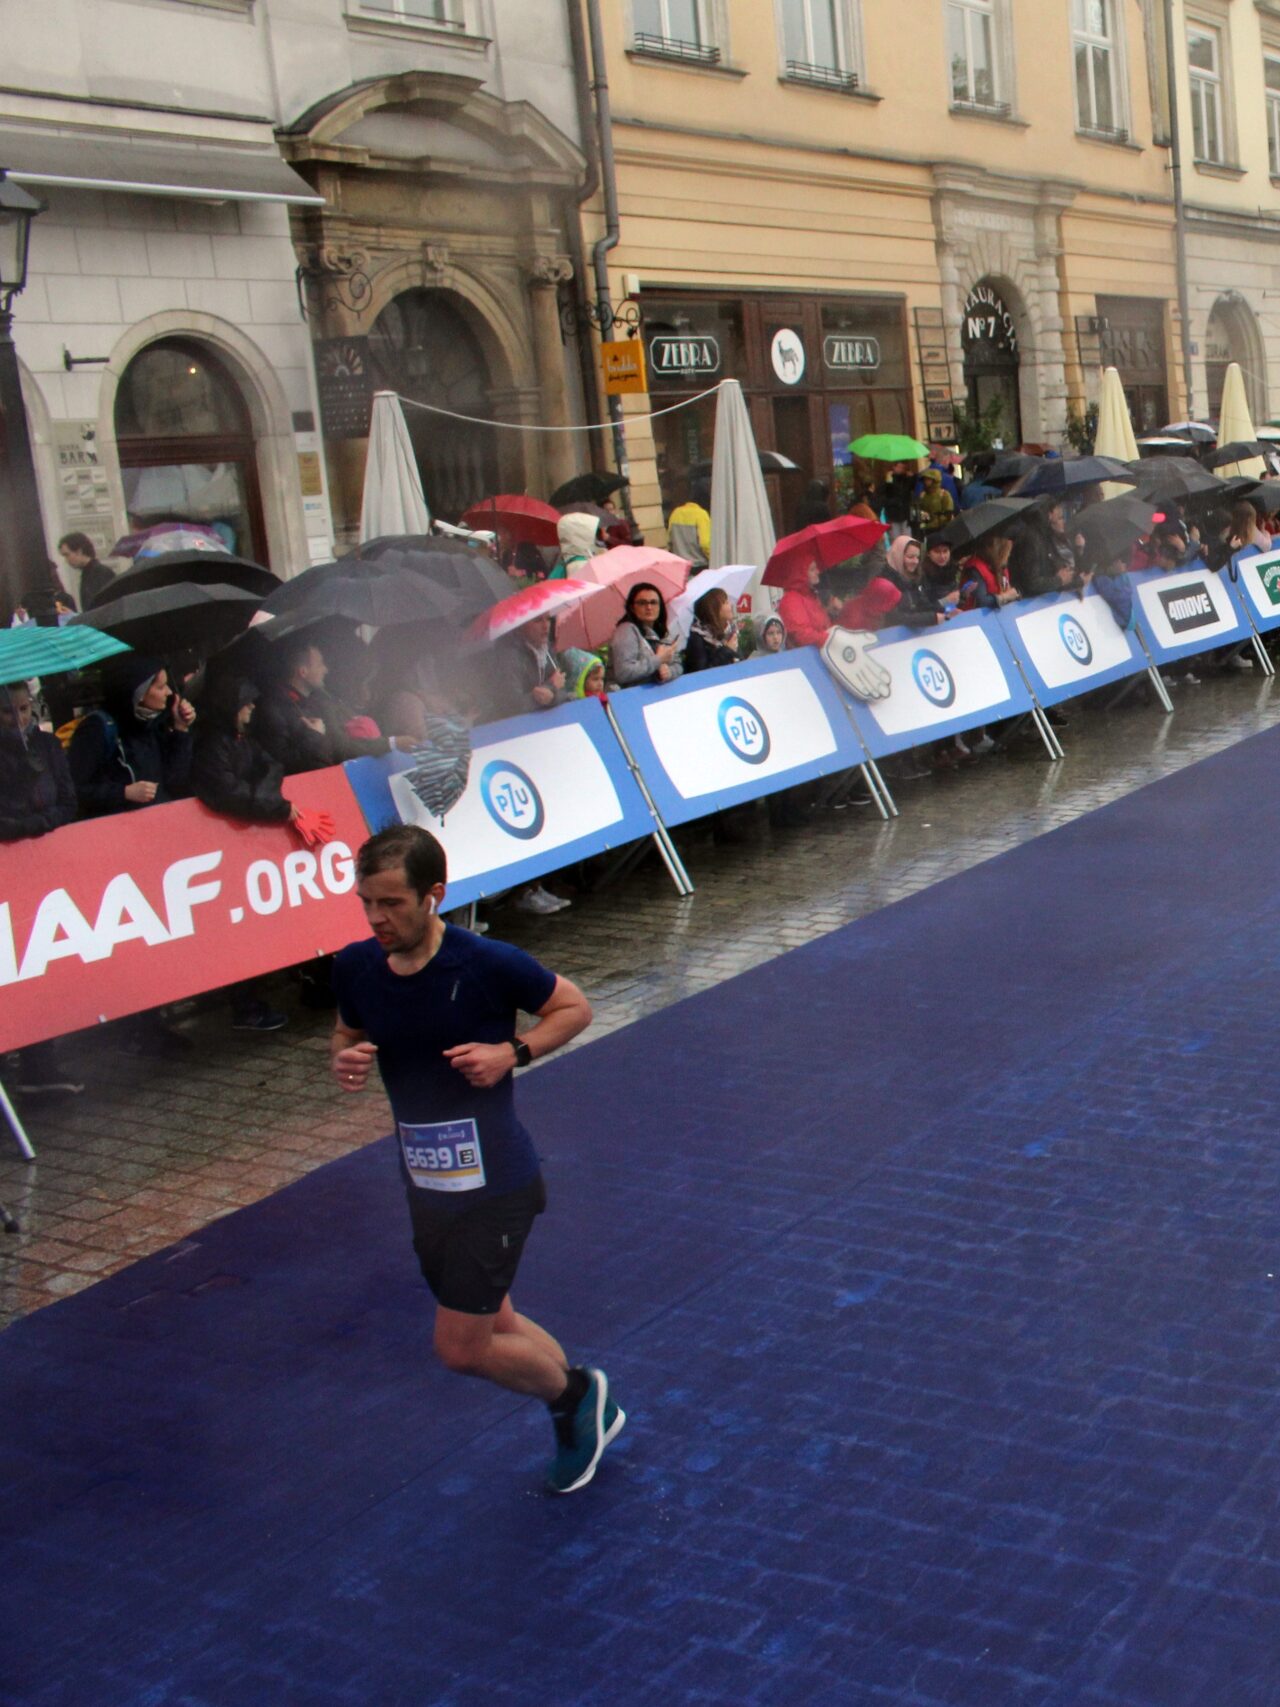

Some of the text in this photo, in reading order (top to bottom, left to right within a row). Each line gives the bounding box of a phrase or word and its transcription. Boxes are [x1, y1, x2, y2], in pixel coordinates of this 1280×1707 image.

[661, 342, 712, 366] ZEBRA
[832, 341, 873, 363] ZEBRA
[1168, 593, 1212, 621] 4MOVE
[922, 666, 945, 691] PZU
[730, 716, 757, 745] PZU
[495, 783, 529, 817] PZU
[0, 841, 356, 987] IAAF.ORG
[406, 1147, 453, 1169] 5639
